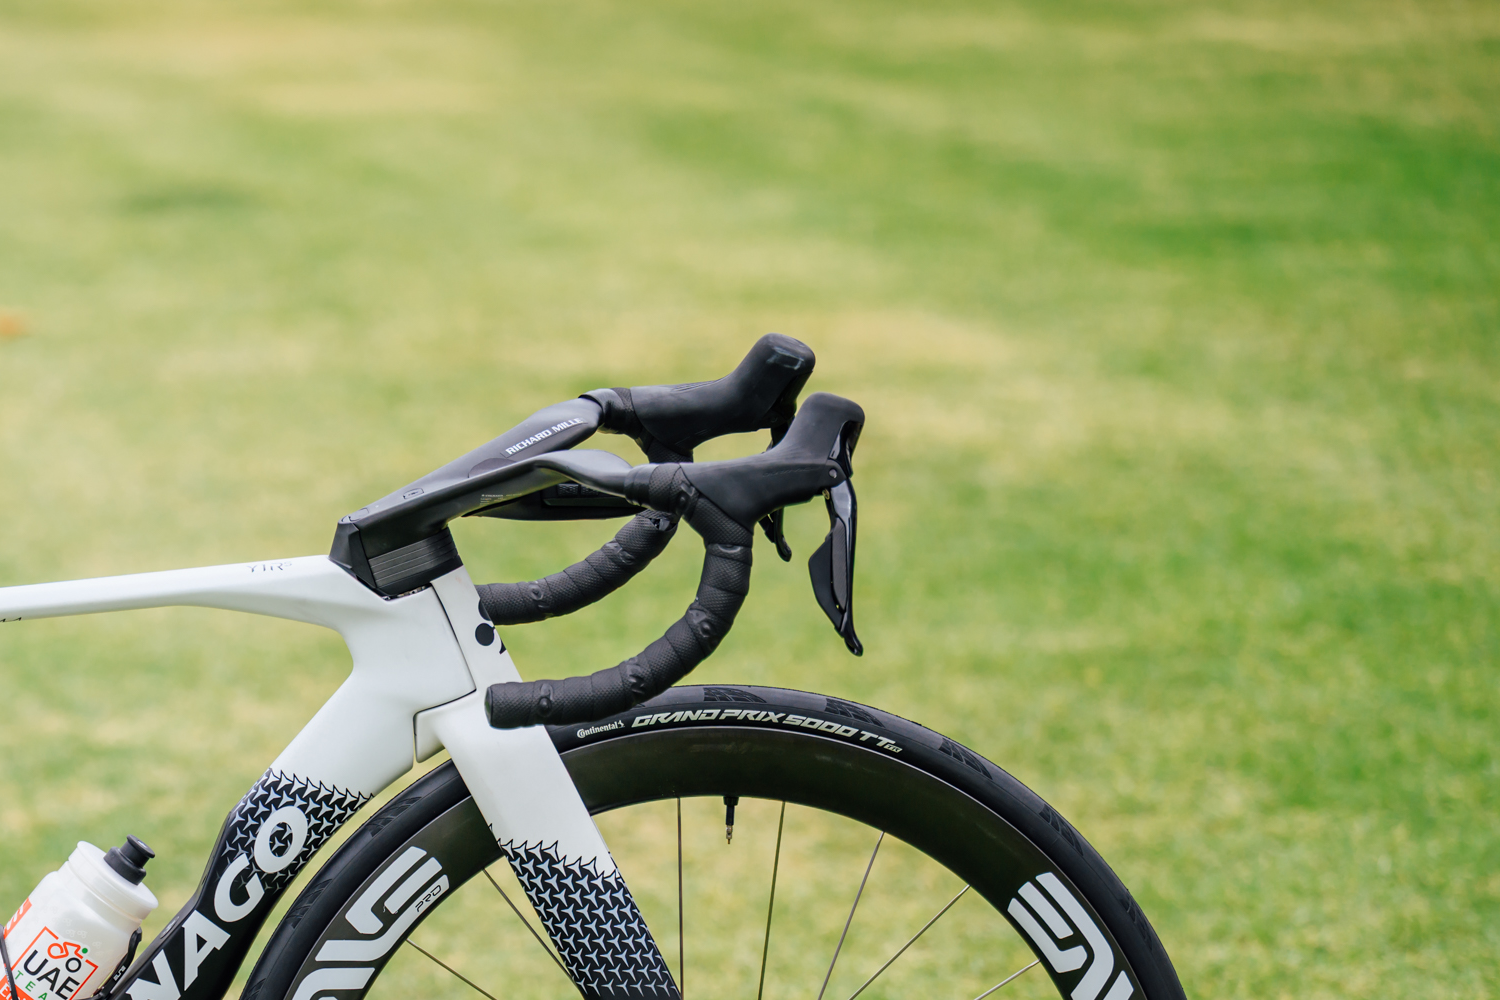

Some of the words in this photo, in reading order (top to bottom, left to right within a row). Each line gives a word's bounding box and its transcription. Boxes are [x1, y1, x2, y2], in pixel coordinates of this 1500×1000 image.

[505, 429, 552, 455] RICHARD
[551, 417, 584, 432] MILLE
[576, 720, 619, 738] Continental
[631, 709, 721, 728] GRAND
[719, 709, 786, 724] PRIX
[782, 714, 860, 737] 5000
[859, 730, 896, 747] TT
[415, 884, 442, 912] PRO
[23, 949, 80, 1000] UAE
